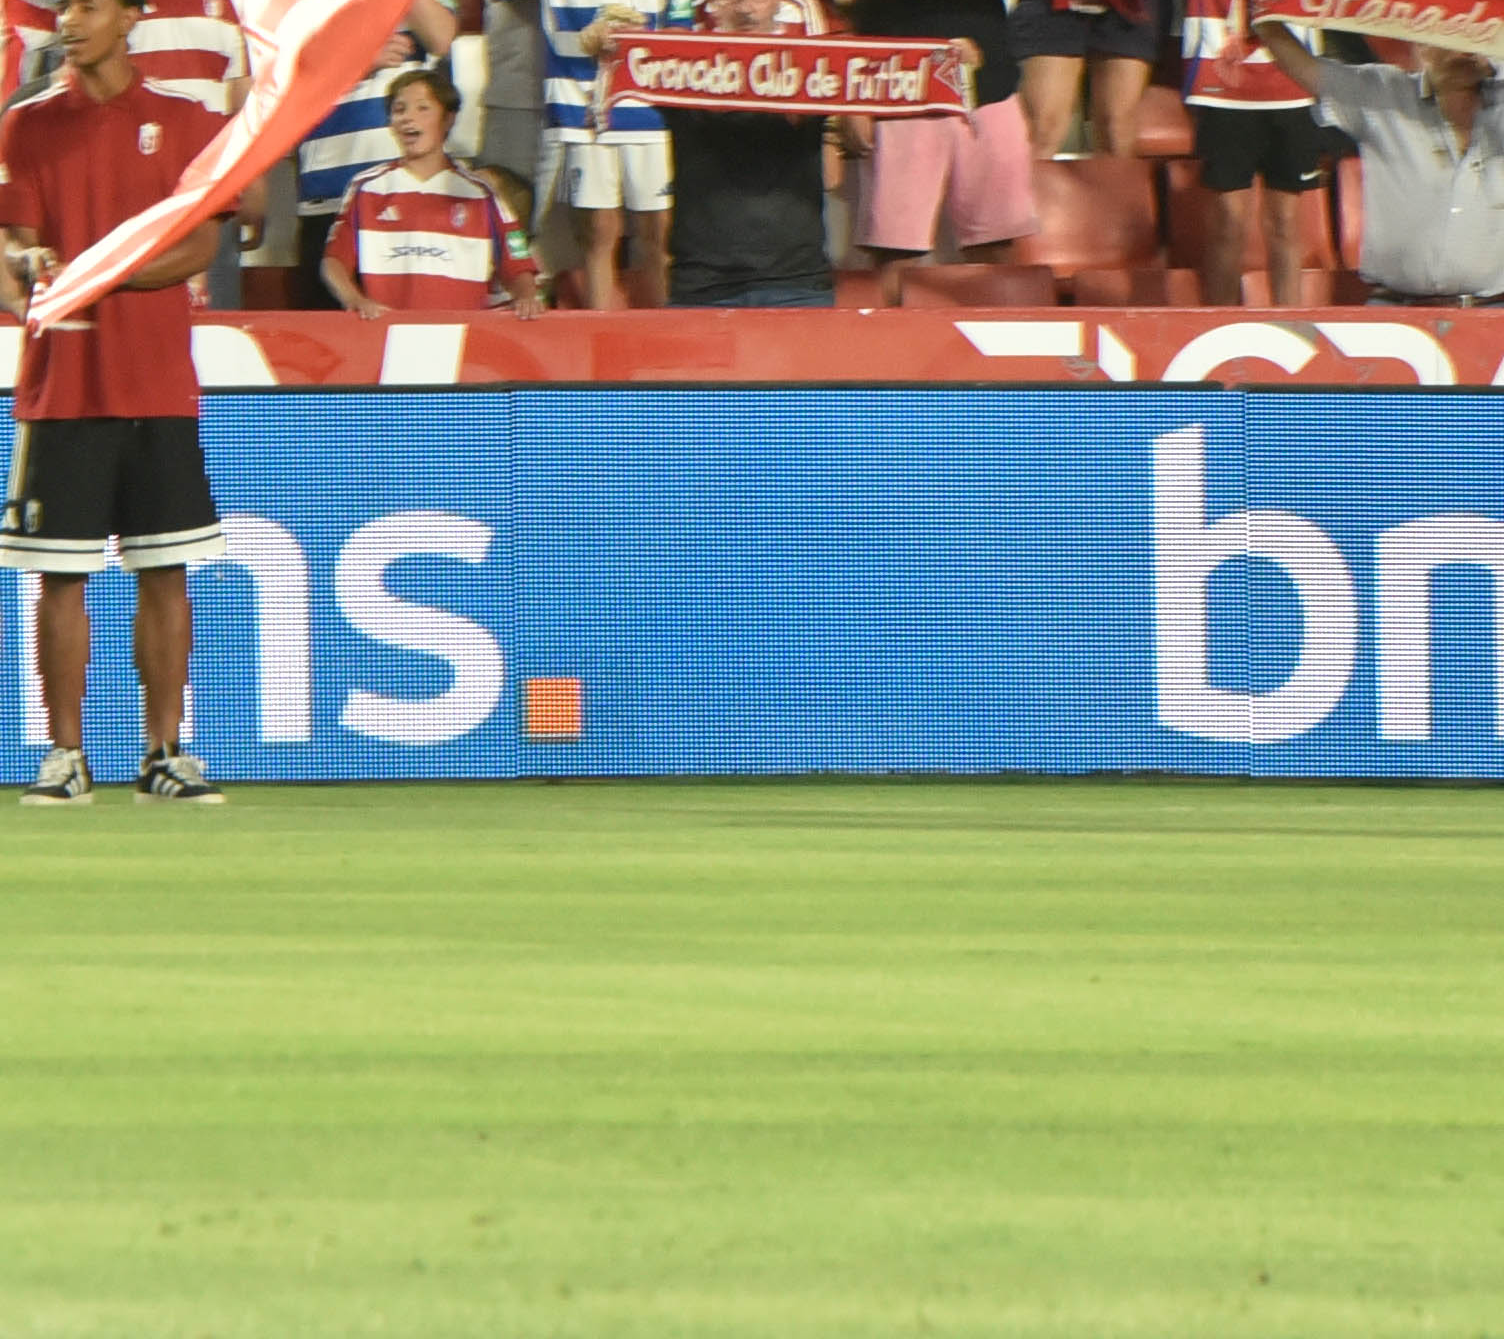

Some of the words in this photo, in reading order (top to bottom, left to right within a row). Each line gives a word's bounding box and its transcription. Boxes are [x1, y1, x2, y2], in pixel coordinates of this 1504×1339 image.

[629, 47, 744, 97] Granada
[748, 48, 801, 100] Club
[804, 55, 840, 97] de
